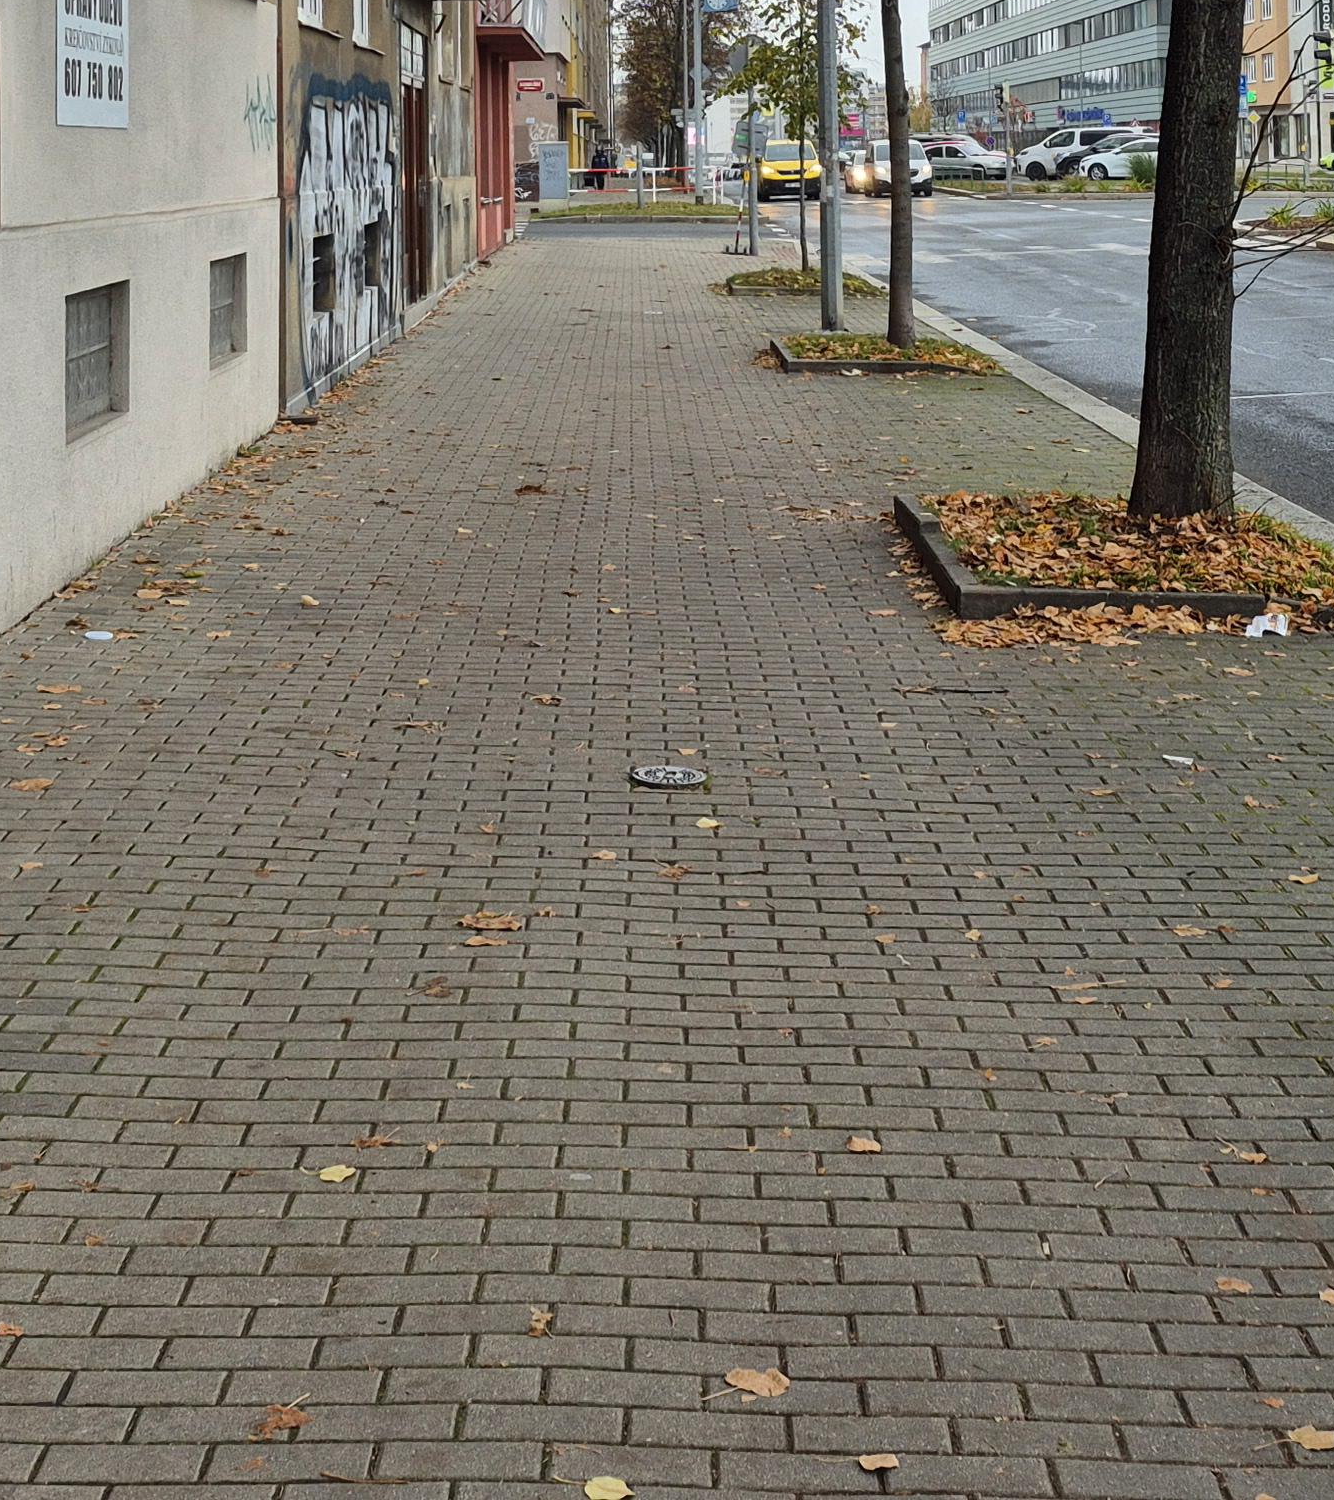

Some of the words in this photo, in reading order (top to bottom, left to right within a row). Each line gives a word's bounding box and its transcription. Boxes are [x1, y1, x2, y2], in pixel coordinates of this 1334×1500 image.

[64, 57, 82, 97] 607
[87, 61, 103, 100] 750
[108, 65, 124, 102] 802
